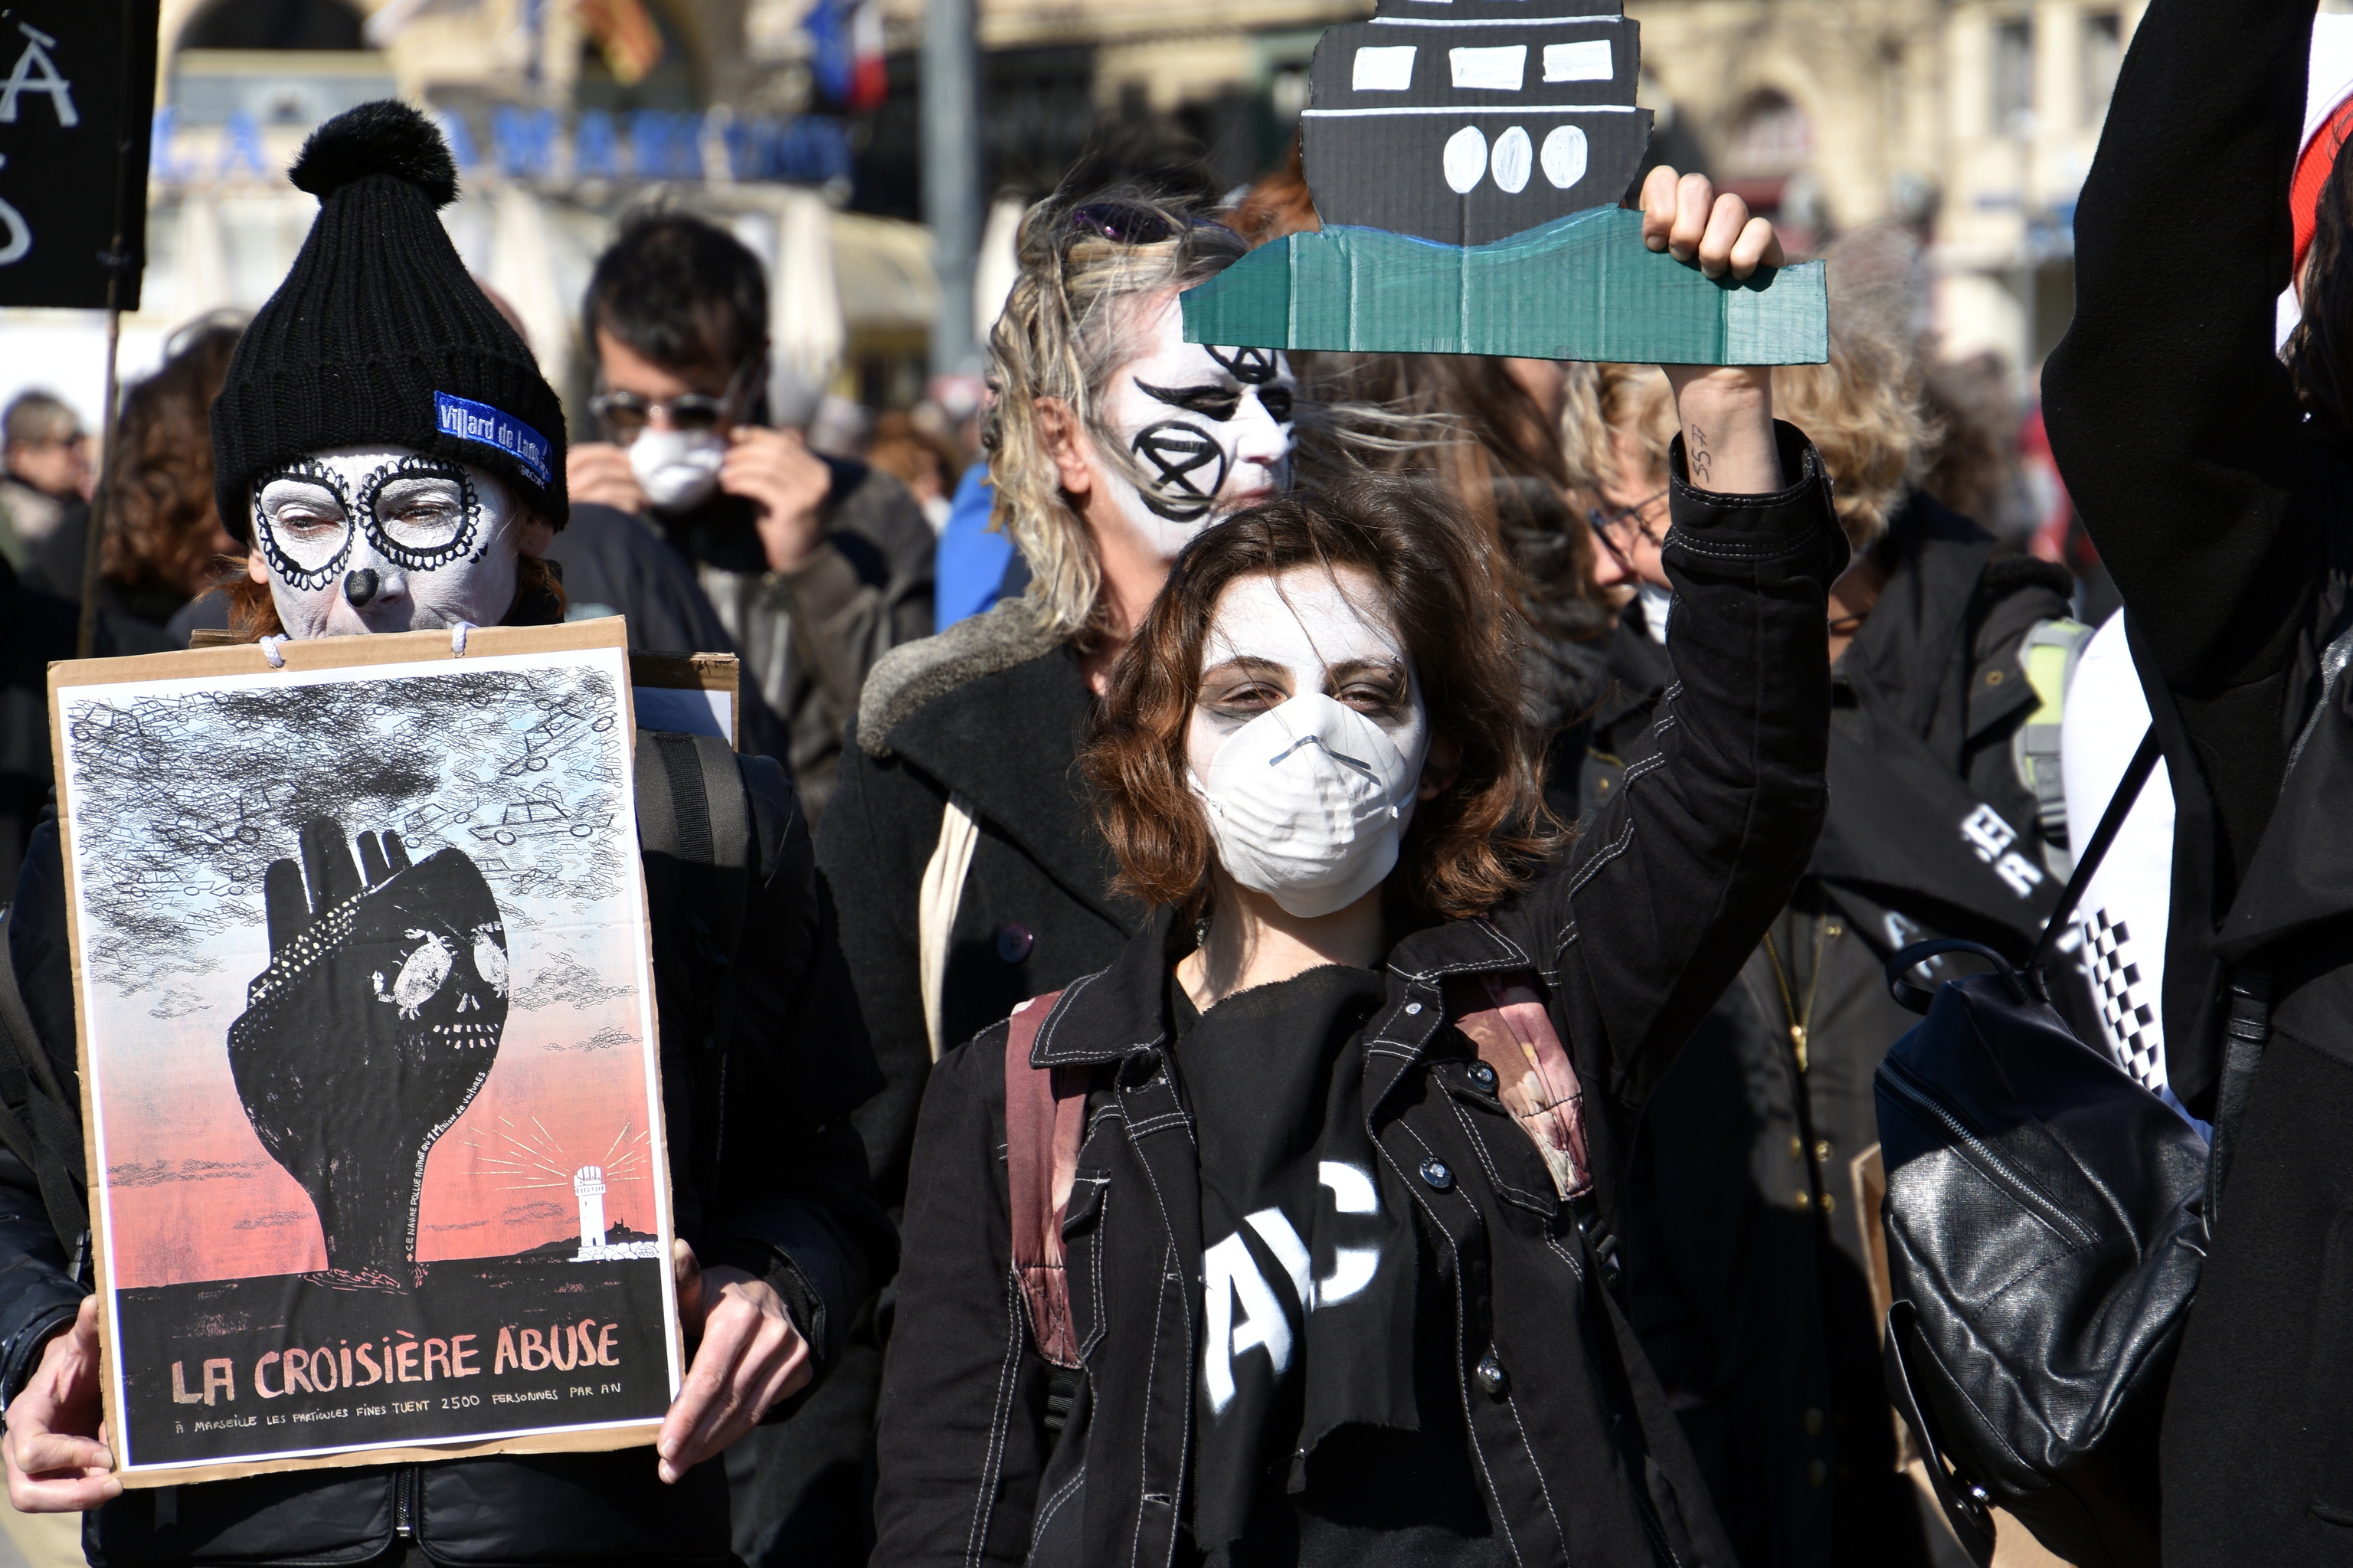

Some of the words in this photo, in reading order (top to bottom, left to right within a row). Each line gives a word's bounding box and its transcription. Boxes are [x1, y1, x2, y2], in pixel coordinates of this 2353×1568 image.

[440, 404, 496, 439] Villard
[498, 423, 514, 448] de
[455, 1105, 466, 1115] de
[414, 1150, 426, 1178] AUTANT
[410, 1177, 421, 1206] POLLUE
[405, 1237, 414, 1252] CE
[171, 1357, 235, 1406] LA
[494, 1318, 620, 1375] ABUSE
[267, 1415, 286, 1426] LES
[391, 1399, 430, 1415] TUENT
[440, 1394, 480, 1410] 2500
[492, 1389, 558, 1405] PERSONNES
[569, 1386, 594, 1399] PAR
[601, 1383, 621, 1394] AN
